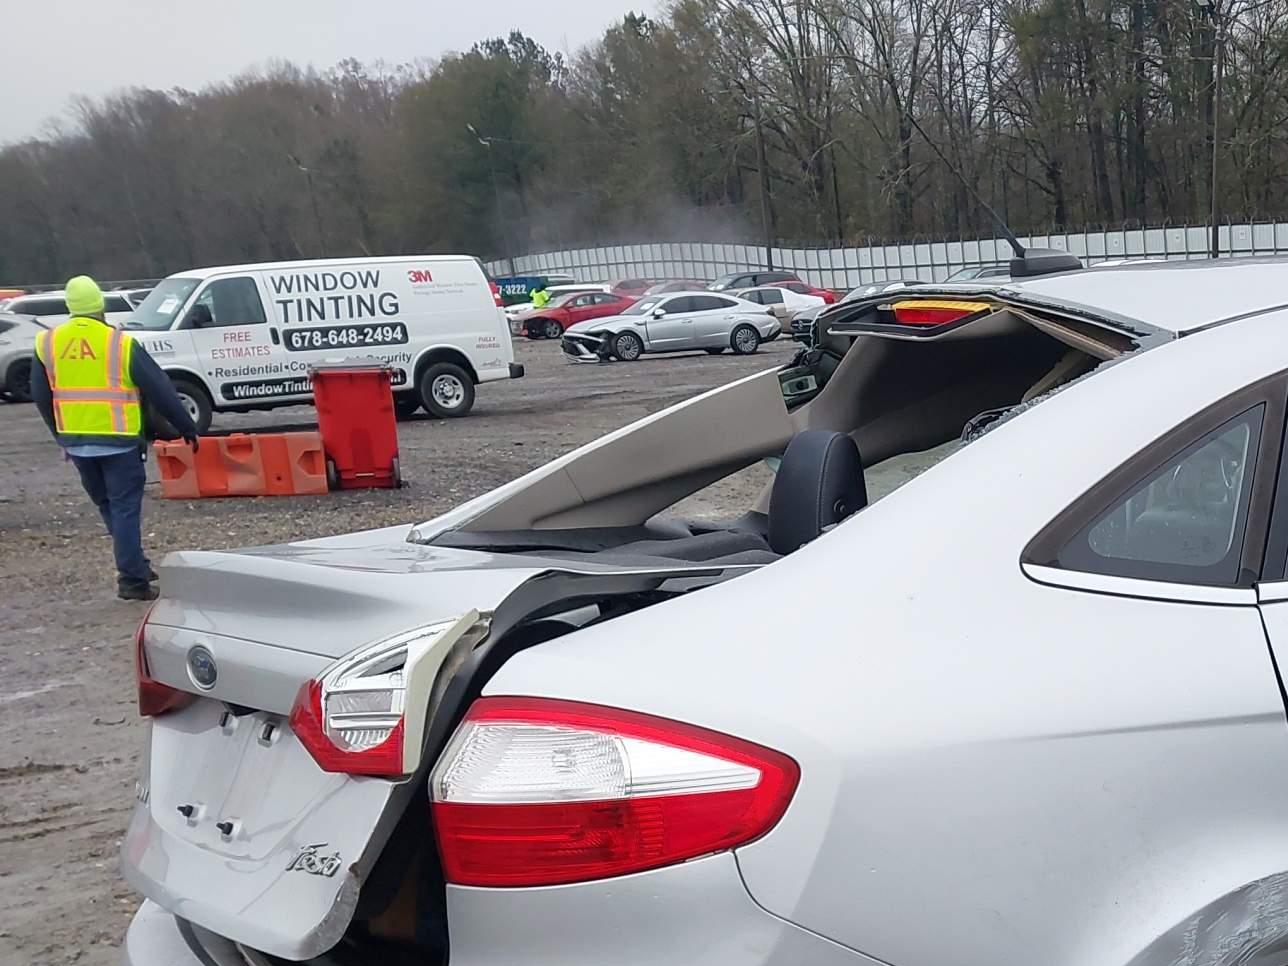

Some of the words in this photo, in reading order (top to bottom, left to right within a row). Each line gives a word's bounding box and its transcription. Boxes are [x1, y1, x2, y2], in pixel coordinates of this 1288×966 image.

[270, 269, 380, 295] WINDOW
[407, 270, 433, 284] 3M
[275, 291, 400, 324] TINTING
[223, 331, 252, 343] FREE
[292, 326, 403, 348] 678-648-2494
[211, 345, 271, 360] ESTIMATES
[215, 362, 283, 378] Residential
[367, 351, 412, 366] curity
